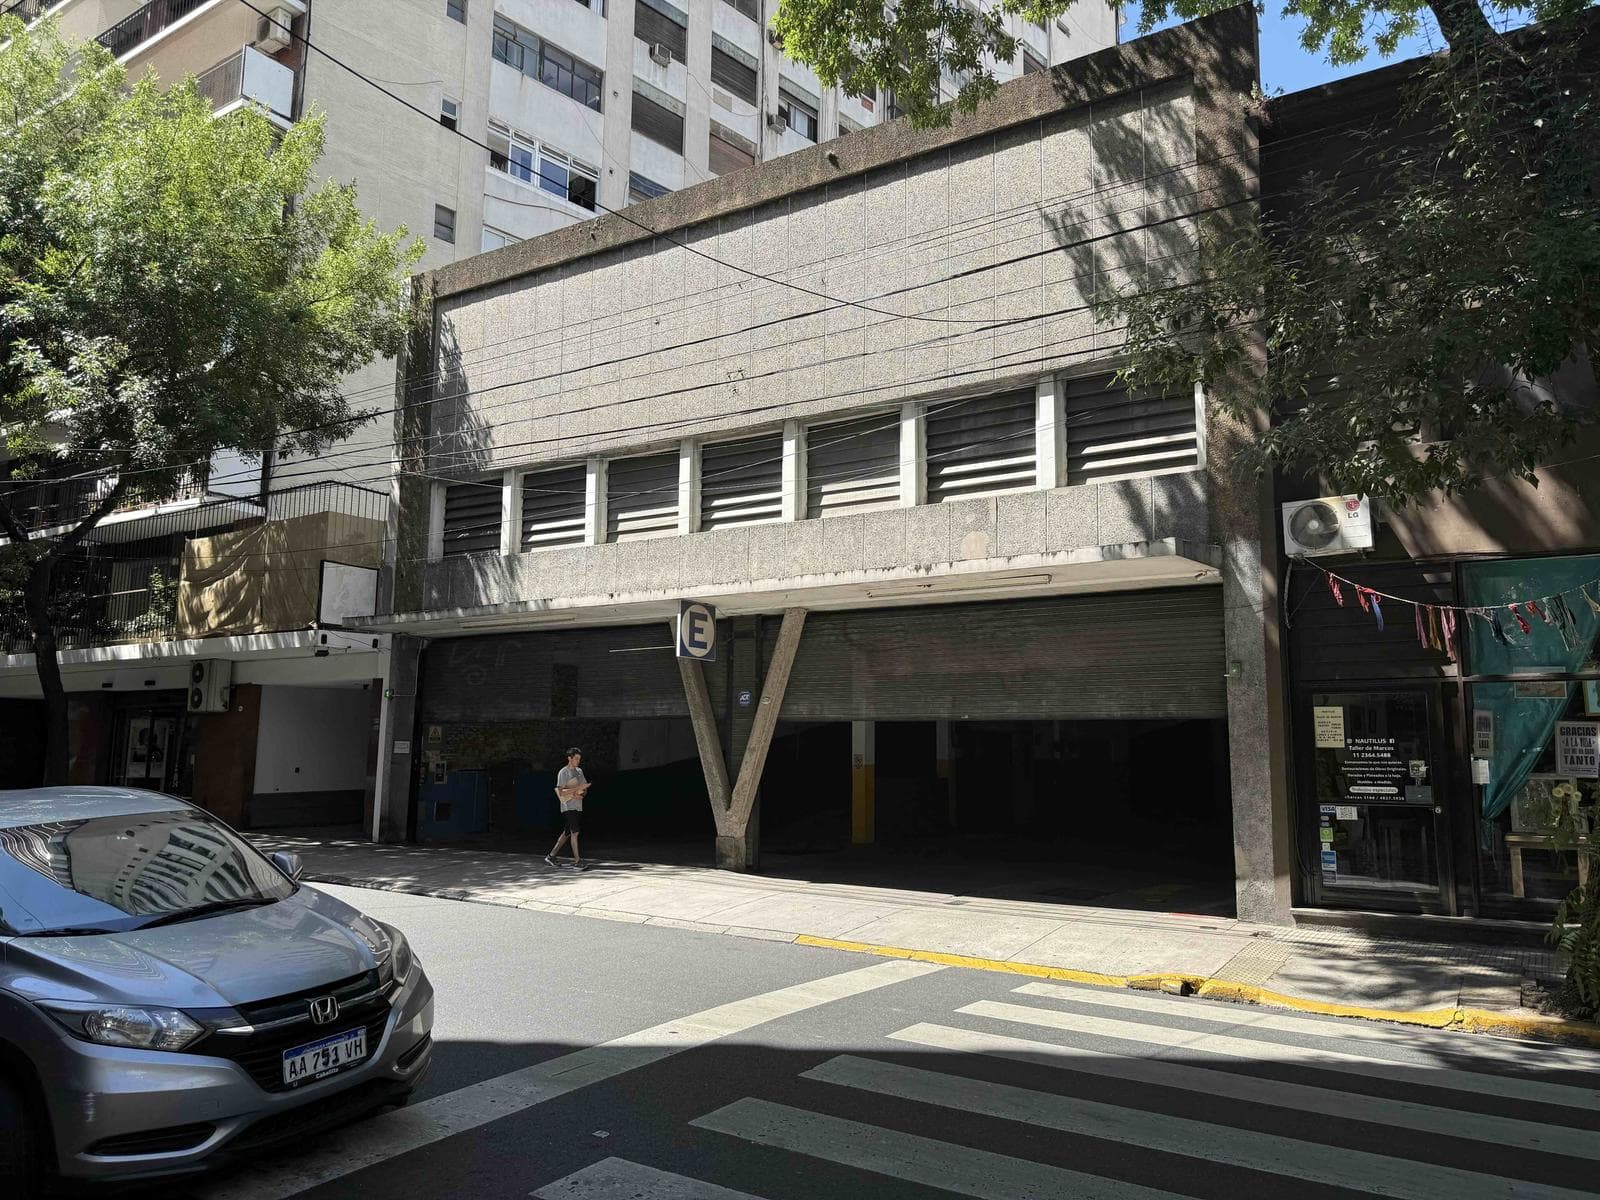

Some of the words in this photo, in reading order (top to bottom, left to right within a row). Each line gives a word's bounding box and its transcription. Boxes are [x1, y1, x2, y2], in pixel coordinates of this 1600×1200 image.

[689, 611, 708, 650] E
[1560, 726, 1597, 737] GRACIAS
[1564, 755, 1595, 766] TANTO
[289, 1057, 307, 1078] AA
[345, 1038, 362, 1058] VH
